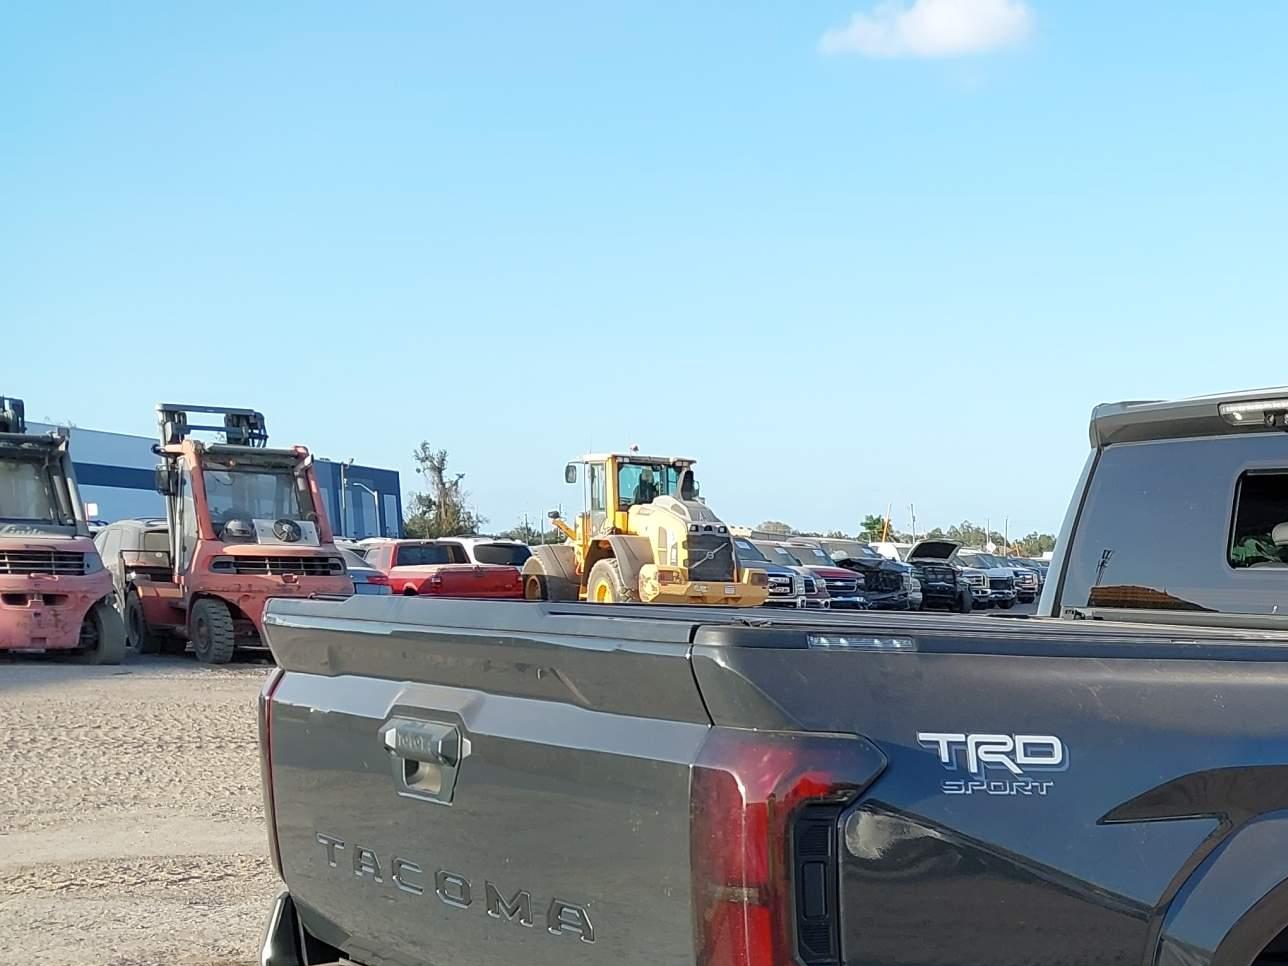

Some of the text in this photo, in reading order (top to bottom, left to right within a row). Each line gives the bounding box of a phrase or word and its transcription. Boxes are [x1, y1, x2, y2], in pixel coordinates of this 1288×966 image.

[917, 733, 1069, 777] TRD
[942, 780, 1054, 796] SPORT
[315, 832, 596, 944] TACOMA
